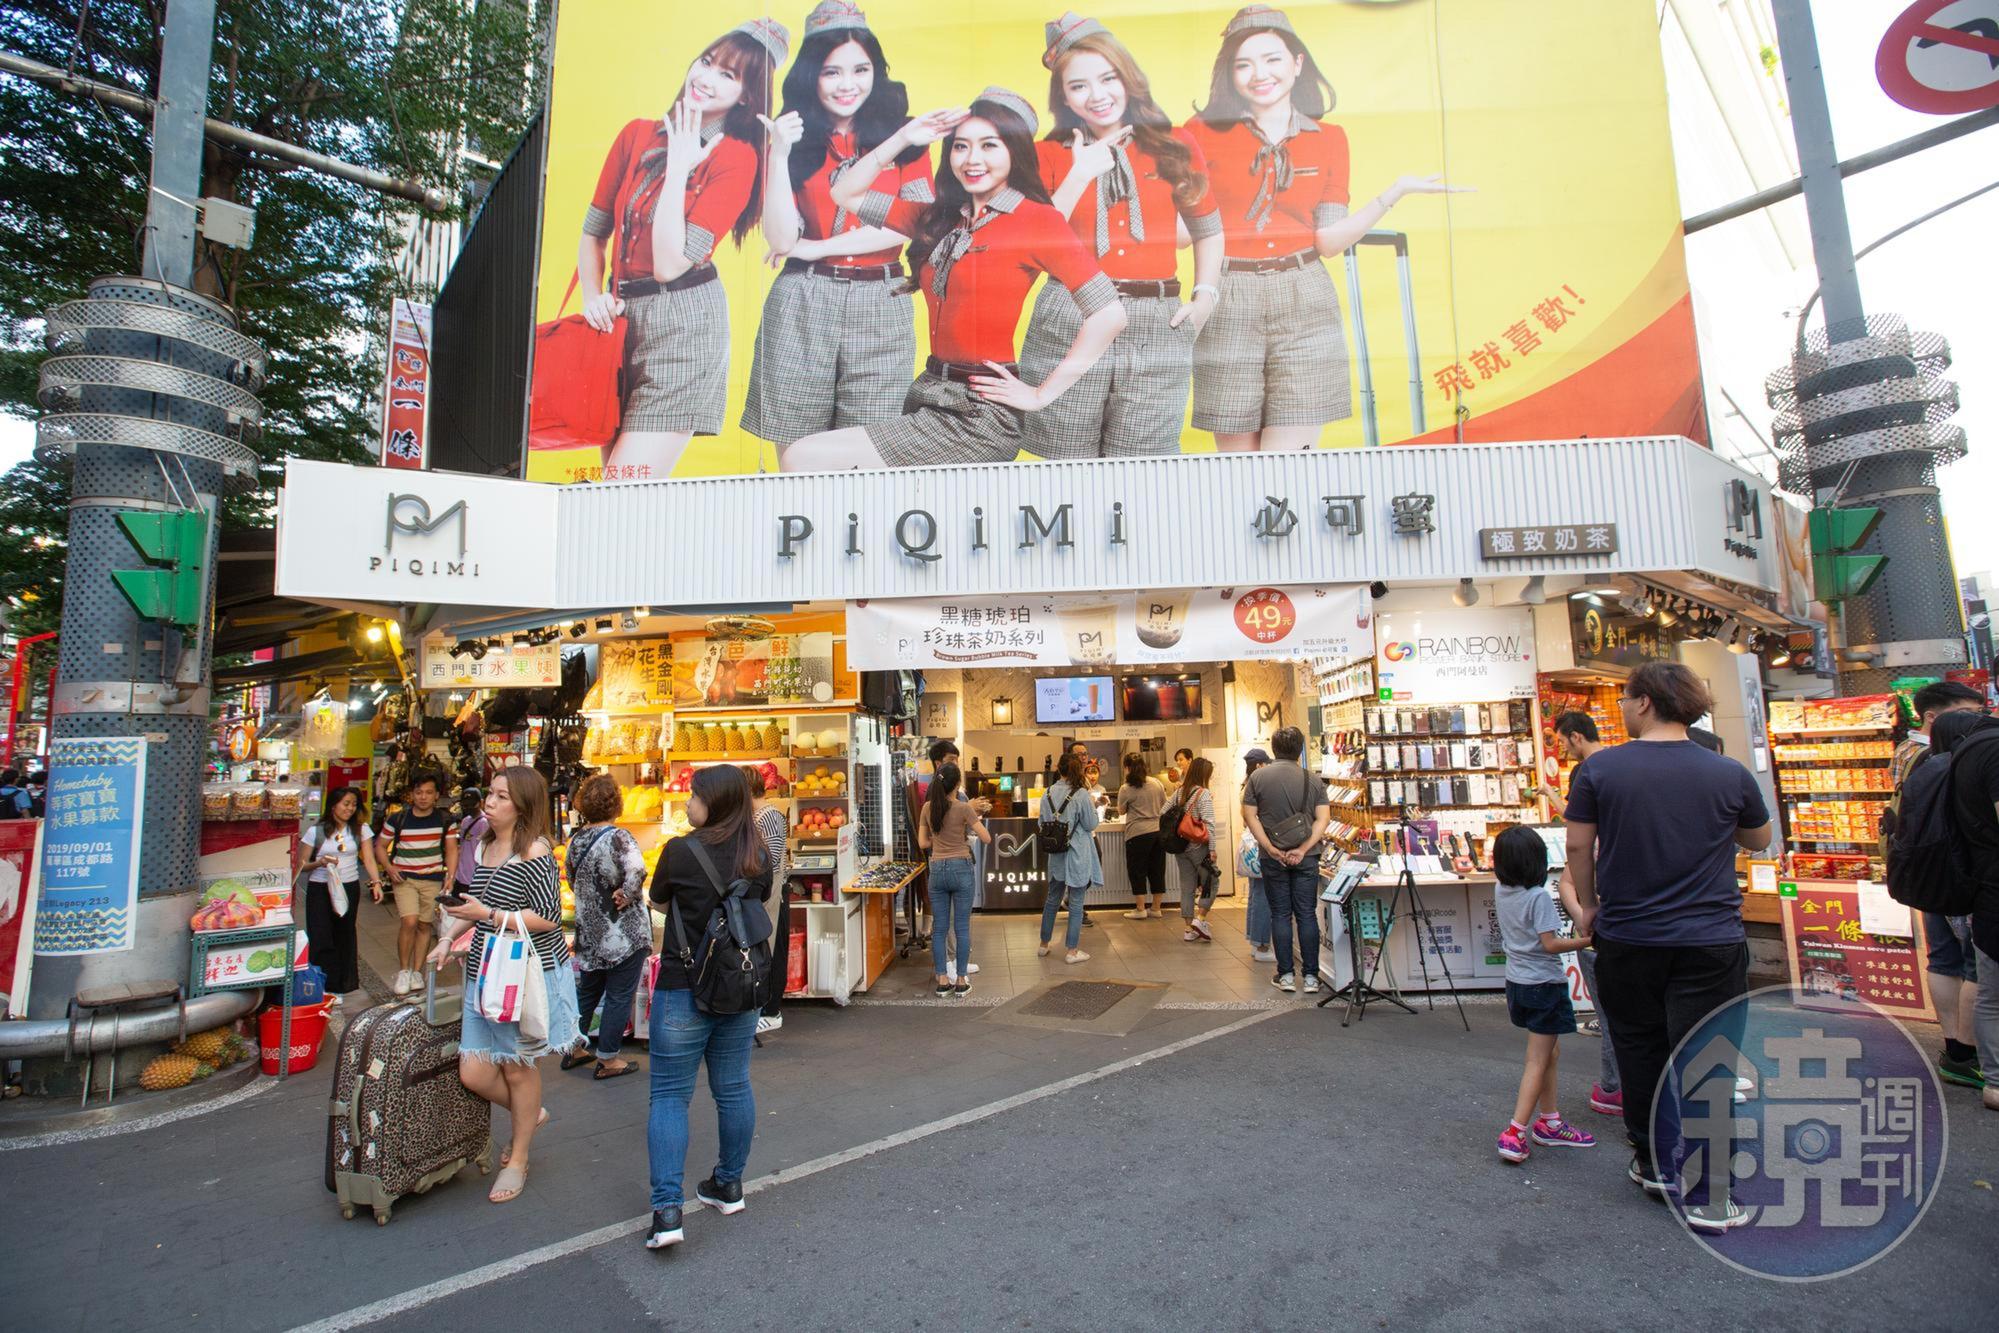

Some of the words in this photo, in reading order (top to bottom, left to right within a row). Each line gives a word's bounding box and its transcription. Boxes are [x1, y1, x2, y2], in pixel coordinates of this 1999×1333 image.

[1433, 284, 1585, 401] 飛就喜歡!
[1251, 491, 1437, 540] 必可蜜
[1490, 526, 1611, 556] 極致奶茶
[940, 605, 1031, 628] 黑糖琥珀
[923, 627, 1044, 650] 珍珠茶奶系列
[1257, 631, 1277, 640] 中杯
[771, 640, 789, 658] 鮮
[1418, 636, 1520, 656] RAINBOW
[638, 647, 655, 683] 花生
[936, 652, 953, 662] Brown
[954, 655, 970, 663] Sugar
[971, 653, 990, 662] Bubble
[1419, 655, 1455, 664] POWER
[1459, 655, 1486, 663] BANK
[1490, 653, 1521, 663] STORE
[656, 643, 673, 696] 黑金剛
[51, 806, 120, 830] 水果募款
[46, 842, 113, 854] 2019/09/01
[56, 866, 91, 878] 117號
[88, 896, 110, 906] 213
[1800, 899, 1845, 915] 金門
[1801, 940, 1832, 948] Taiwan
[1886, 947, 1911, 955] patch
